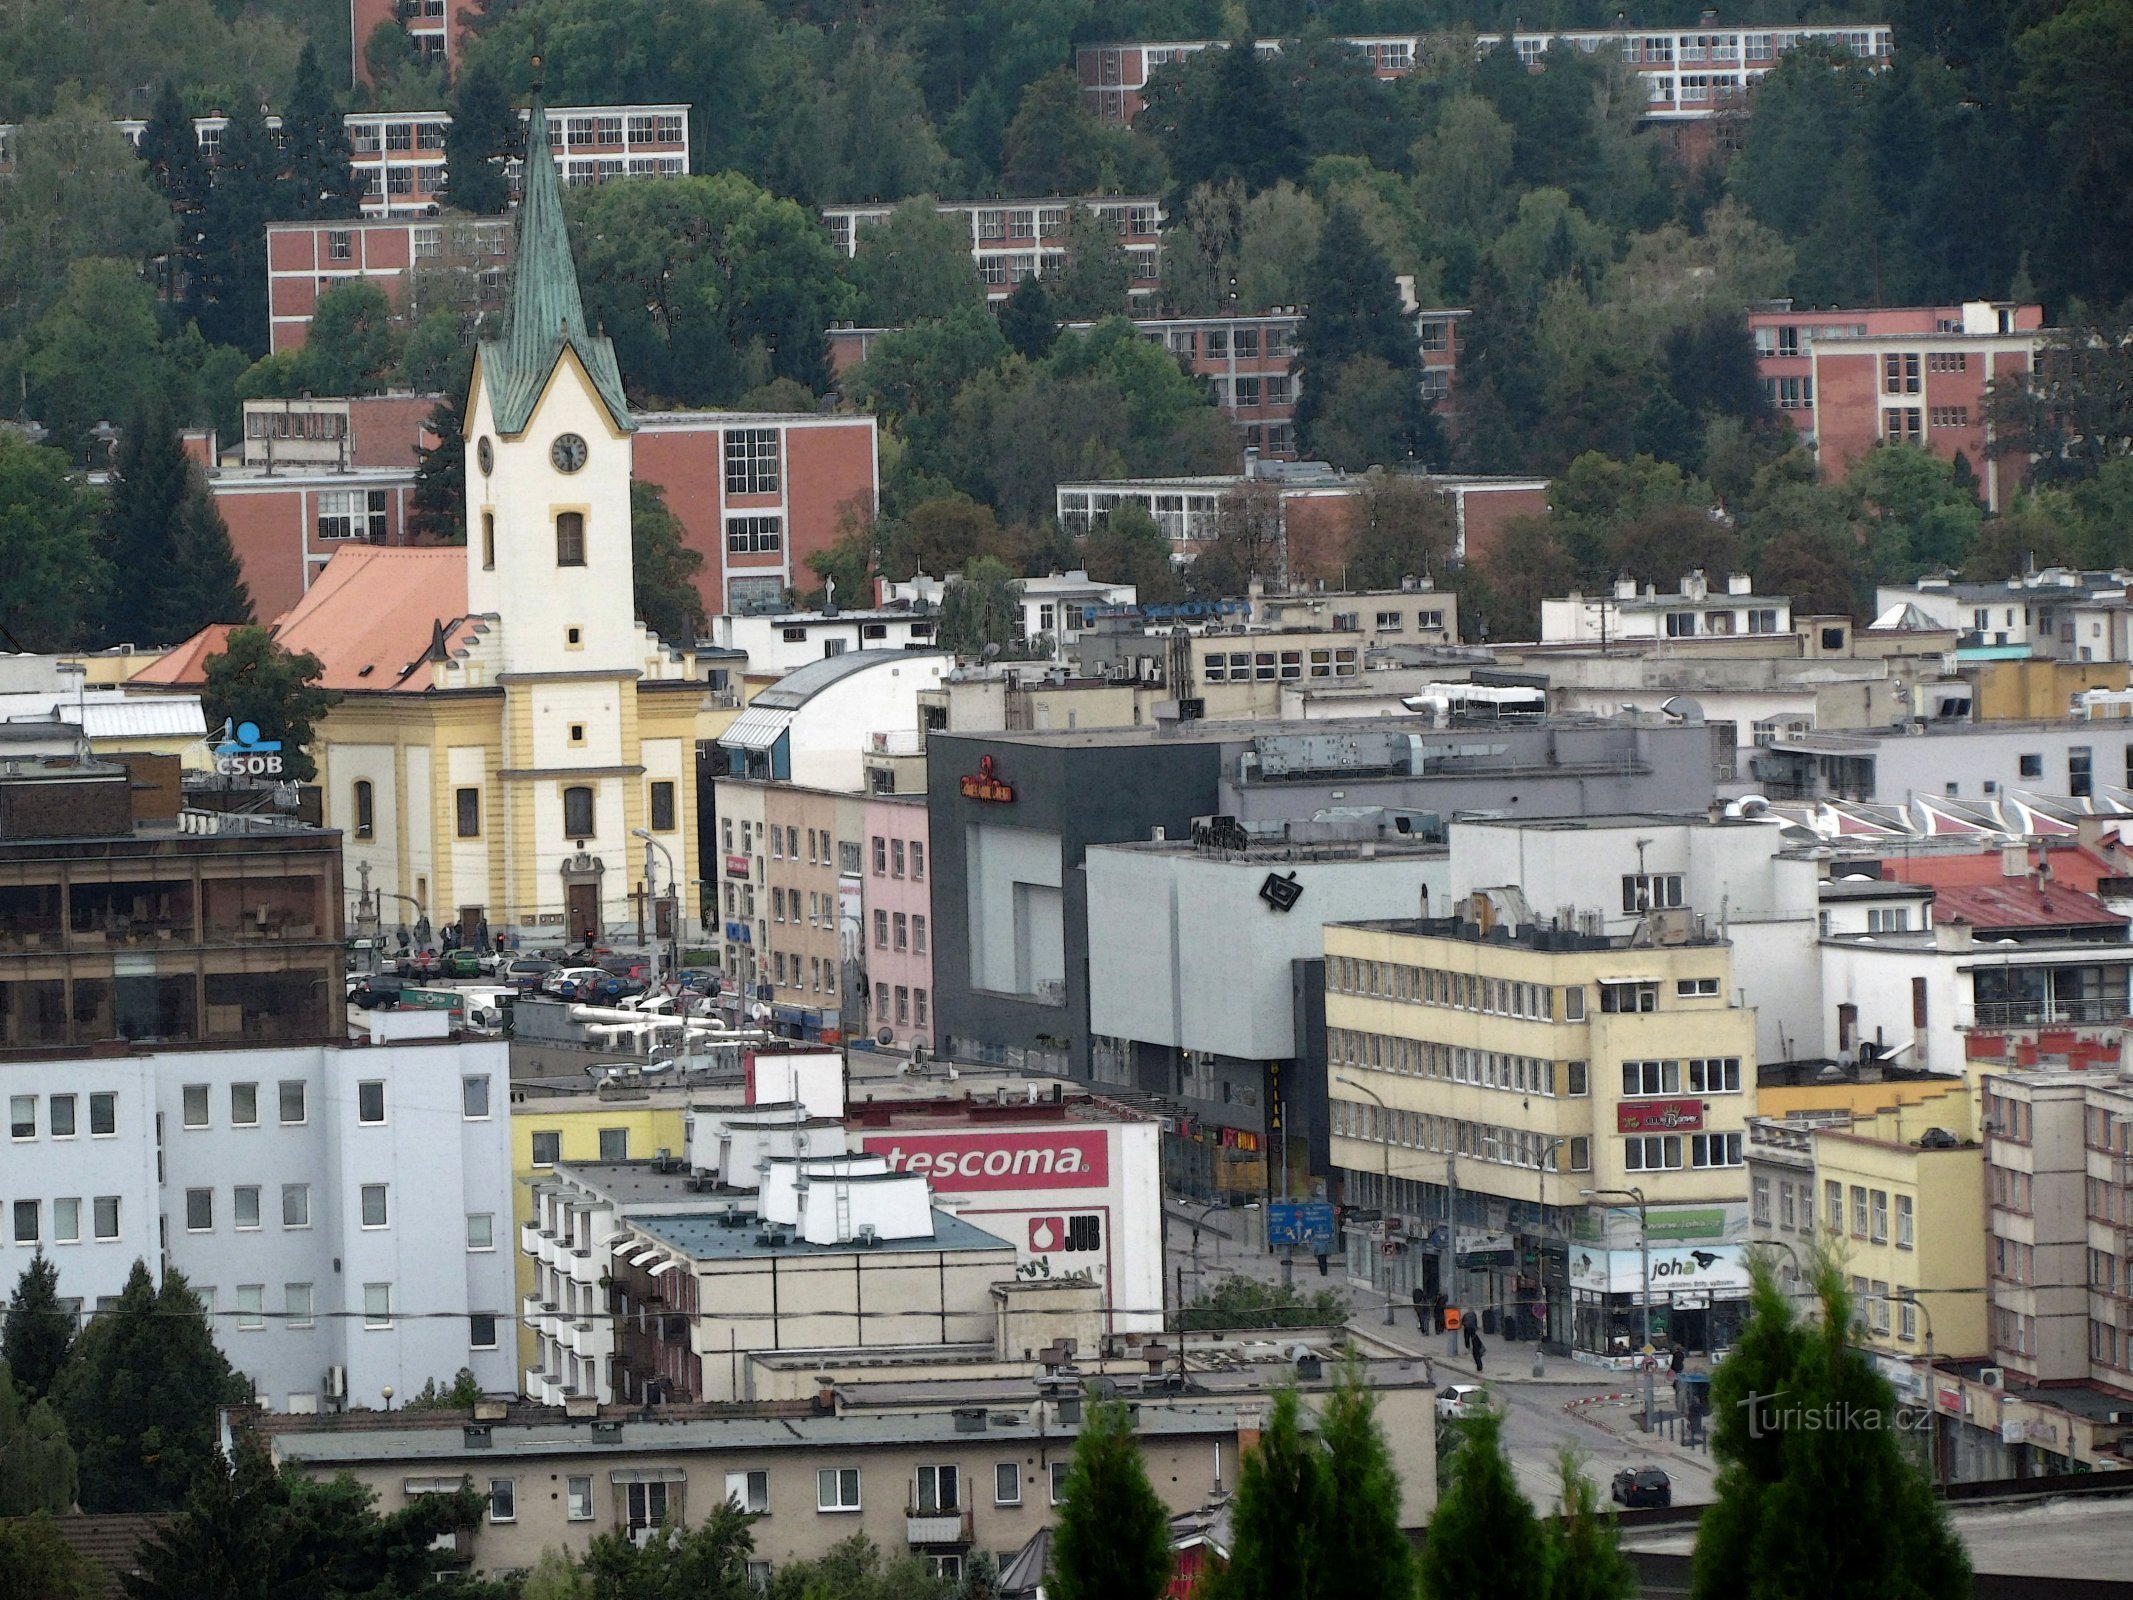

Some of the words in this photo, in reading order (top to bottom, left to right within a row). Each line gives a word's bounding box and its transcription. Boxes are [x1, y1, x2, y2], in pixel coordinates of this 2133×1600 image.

[1270, 1063, 1281, 1129] BILLA
[1064, 1215, 1101, 1252] JUB
[1650, 1257, 1696, 1282] joha
